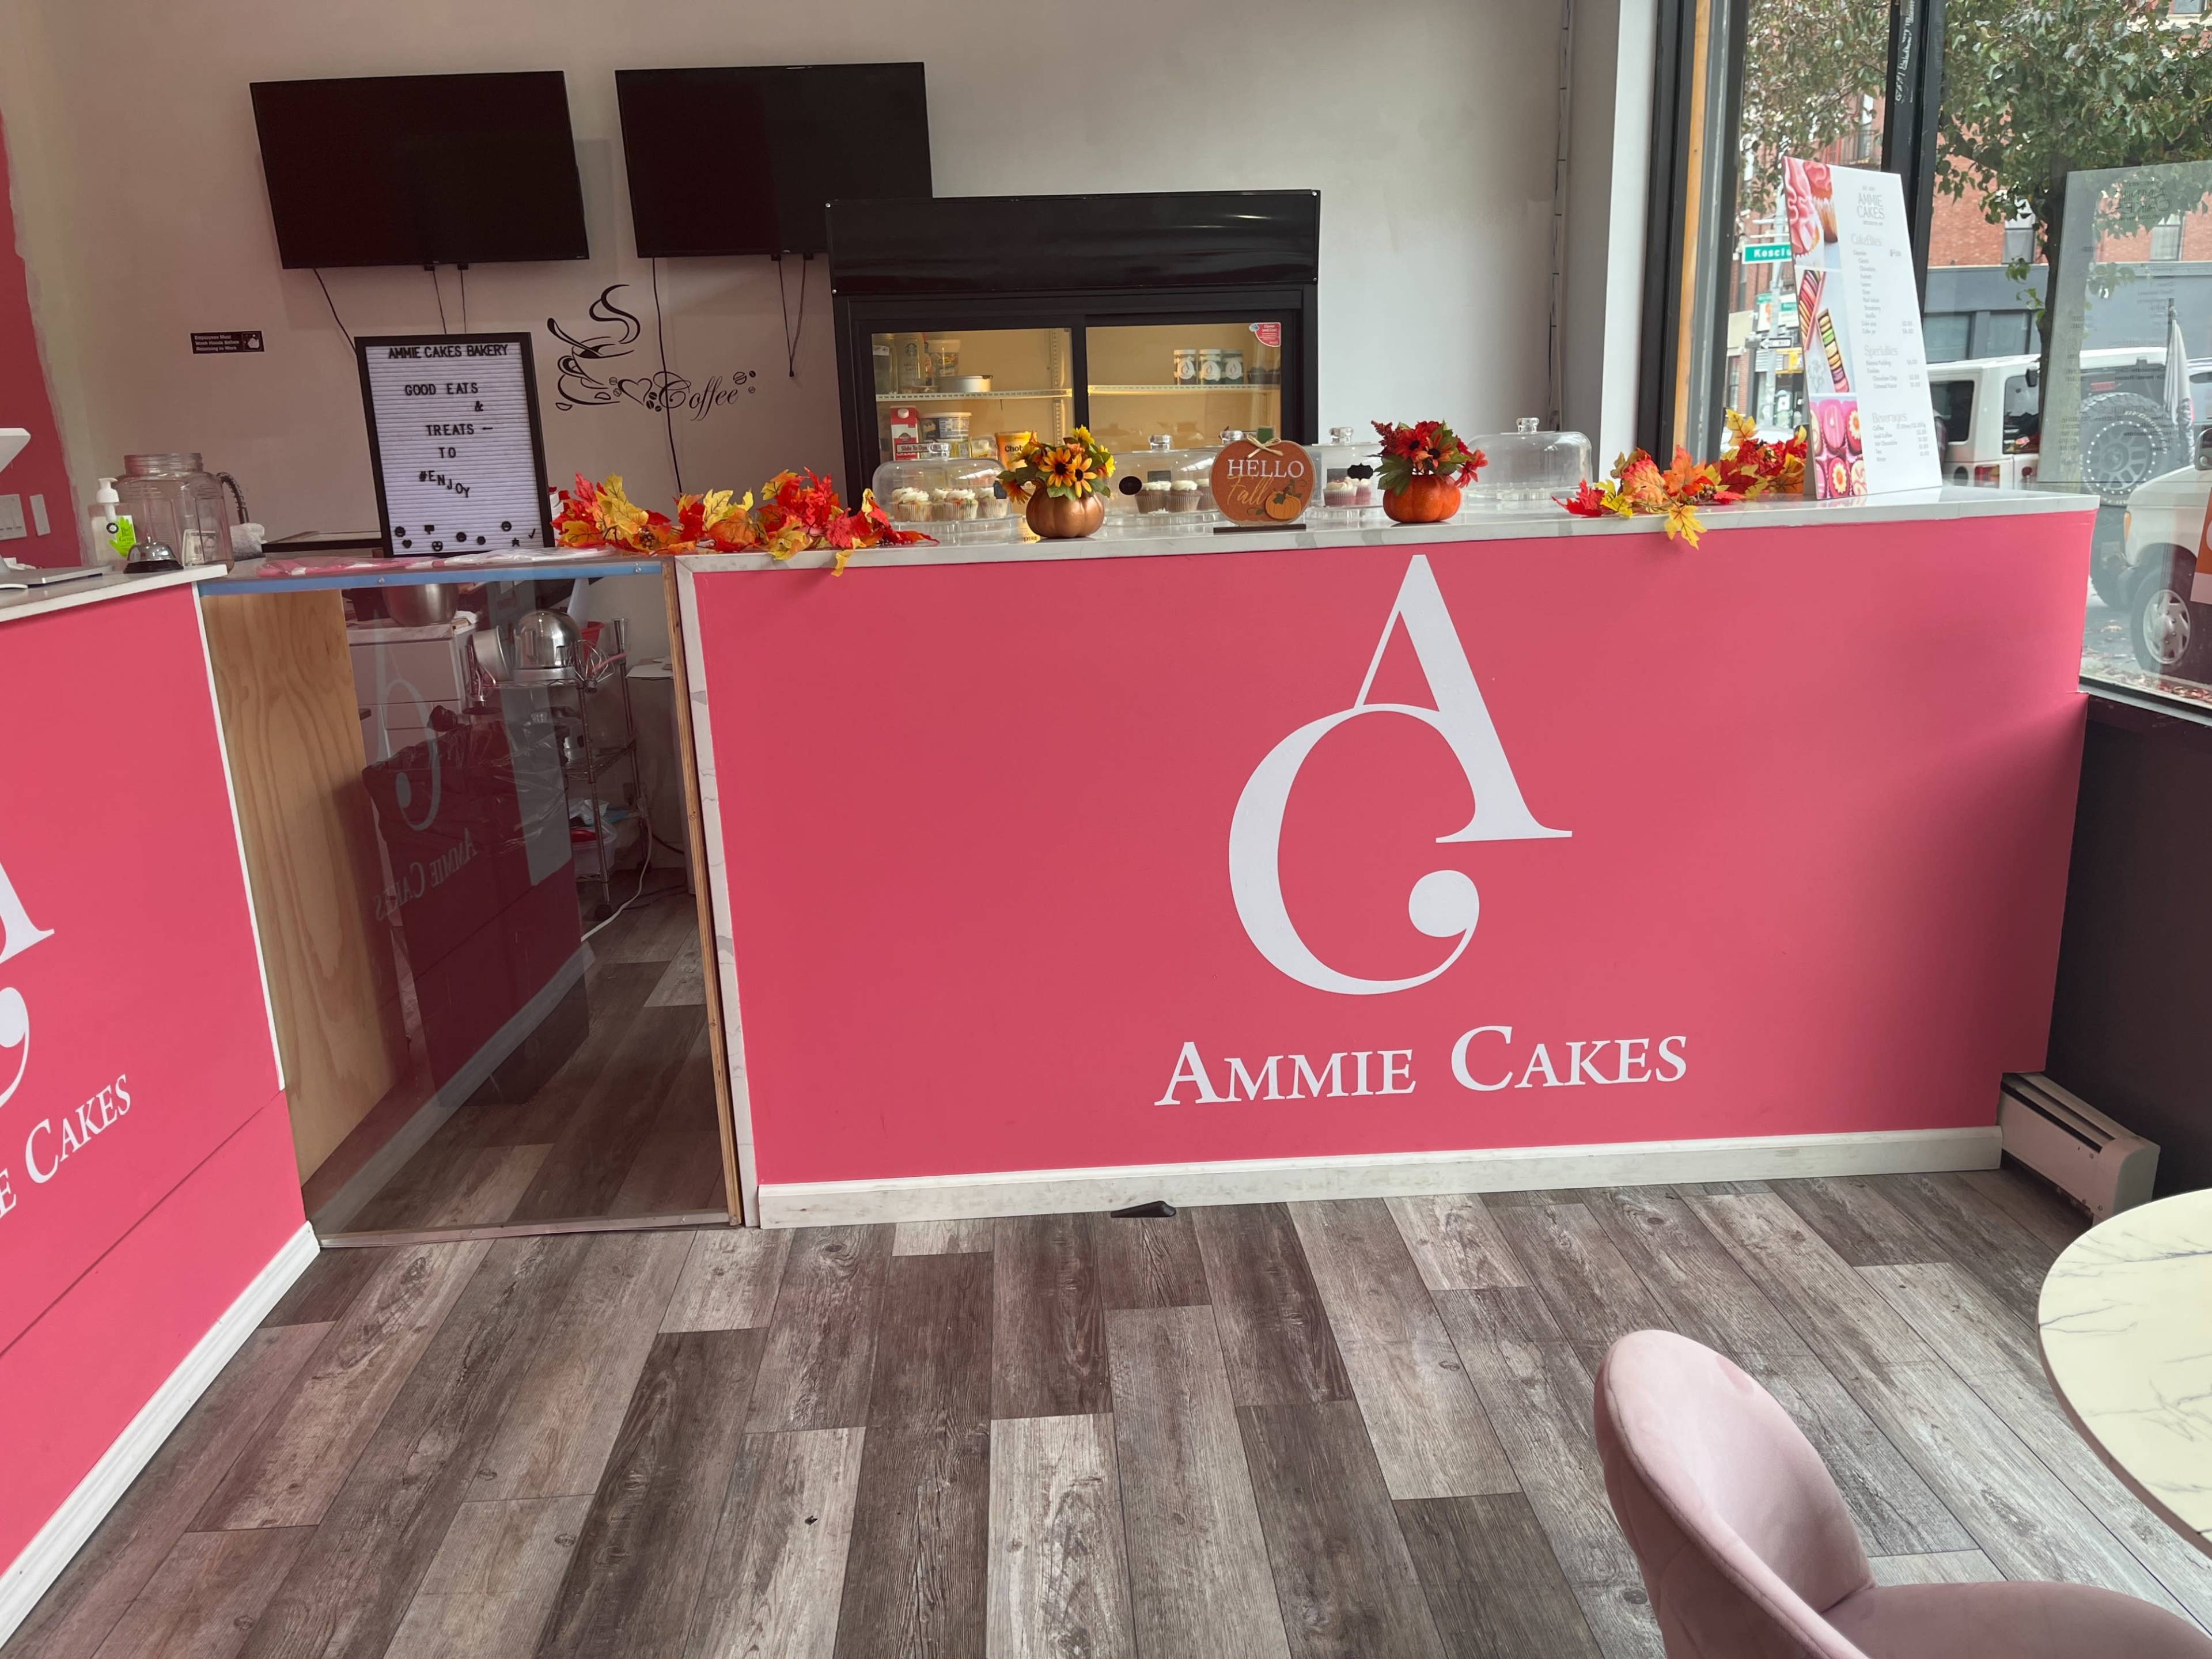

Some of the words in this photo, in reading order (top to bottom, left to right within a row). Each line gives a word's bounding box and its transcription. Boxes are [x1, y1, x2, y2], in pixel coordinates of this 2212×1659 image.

[1858, 192, 1883, 207] AMMIE
[1857, 205, 1885, 219] CAKES
[388, 346, 422, 359] AMMIE
[425, 345, 462, 358] CAKES
[467, 344, 509, 357] BAKERY
[404, 383, 437, 396] GOOD
[447, 382, 479, 395] EATS
[653, 370, 738, 421] Coffee
[475, 400, 484, 412] &
[425, 423, 475, 437] TREATS
[438, 446, 457, 459] TO
[1004, 444, 1024, 453] Chob
[1227, 459, 1305, 479] HELLO
[418, 470, 471, 498] #ENJOY
[1226, 475, 1275, 506] Fall
[1153, 1040, 1418, 1107] AMMIE
[1450, 1024, 1688, 1092] CAKES
[24, 1074, 132, 1184] CAKES
